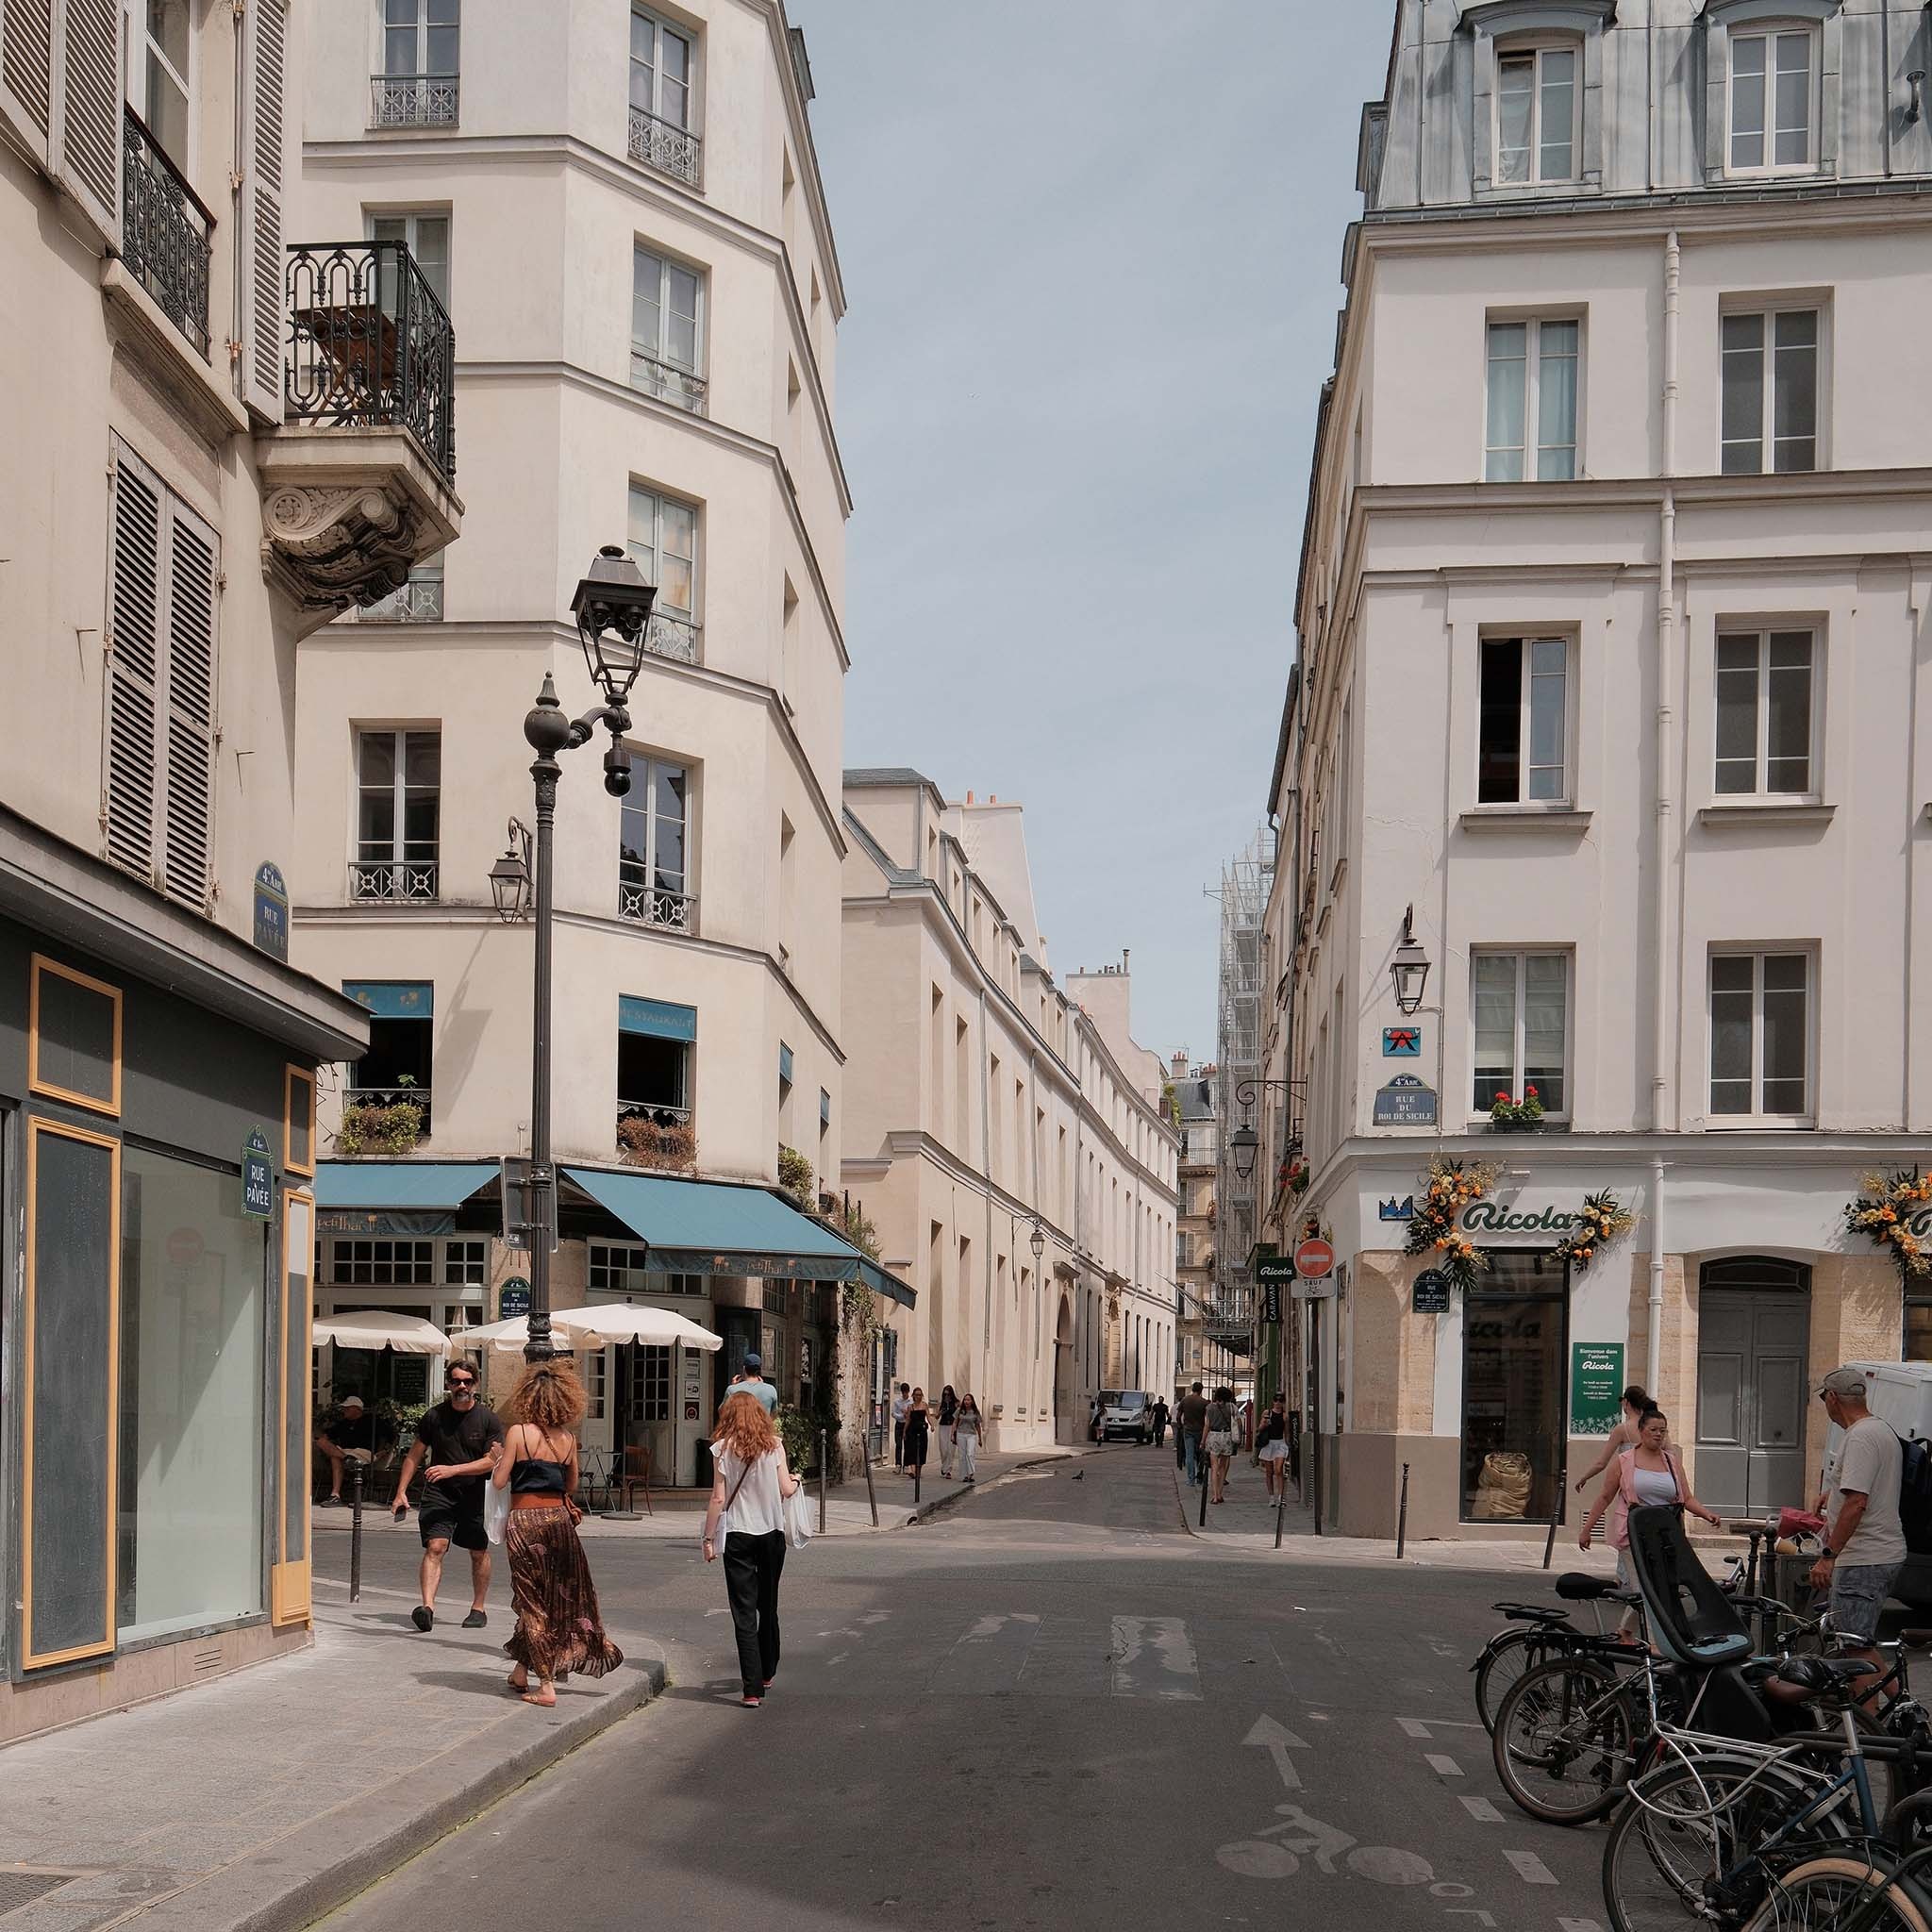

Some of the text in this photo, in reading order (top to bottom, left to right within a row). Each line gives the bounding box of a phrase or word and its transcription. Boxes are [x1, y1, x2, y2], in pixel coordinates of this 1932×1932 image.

[264, 906, 278, 925] RUE
[251, 1164, 265, 1182] RUE
[246, 1186, 270, 1207] PAVÉE
[1462, 1202, 1573, 1230] Ricola
[1260, 1266, 1292, 1276] Ricola
[1582, 1361, 1615, 1371] Ricola
